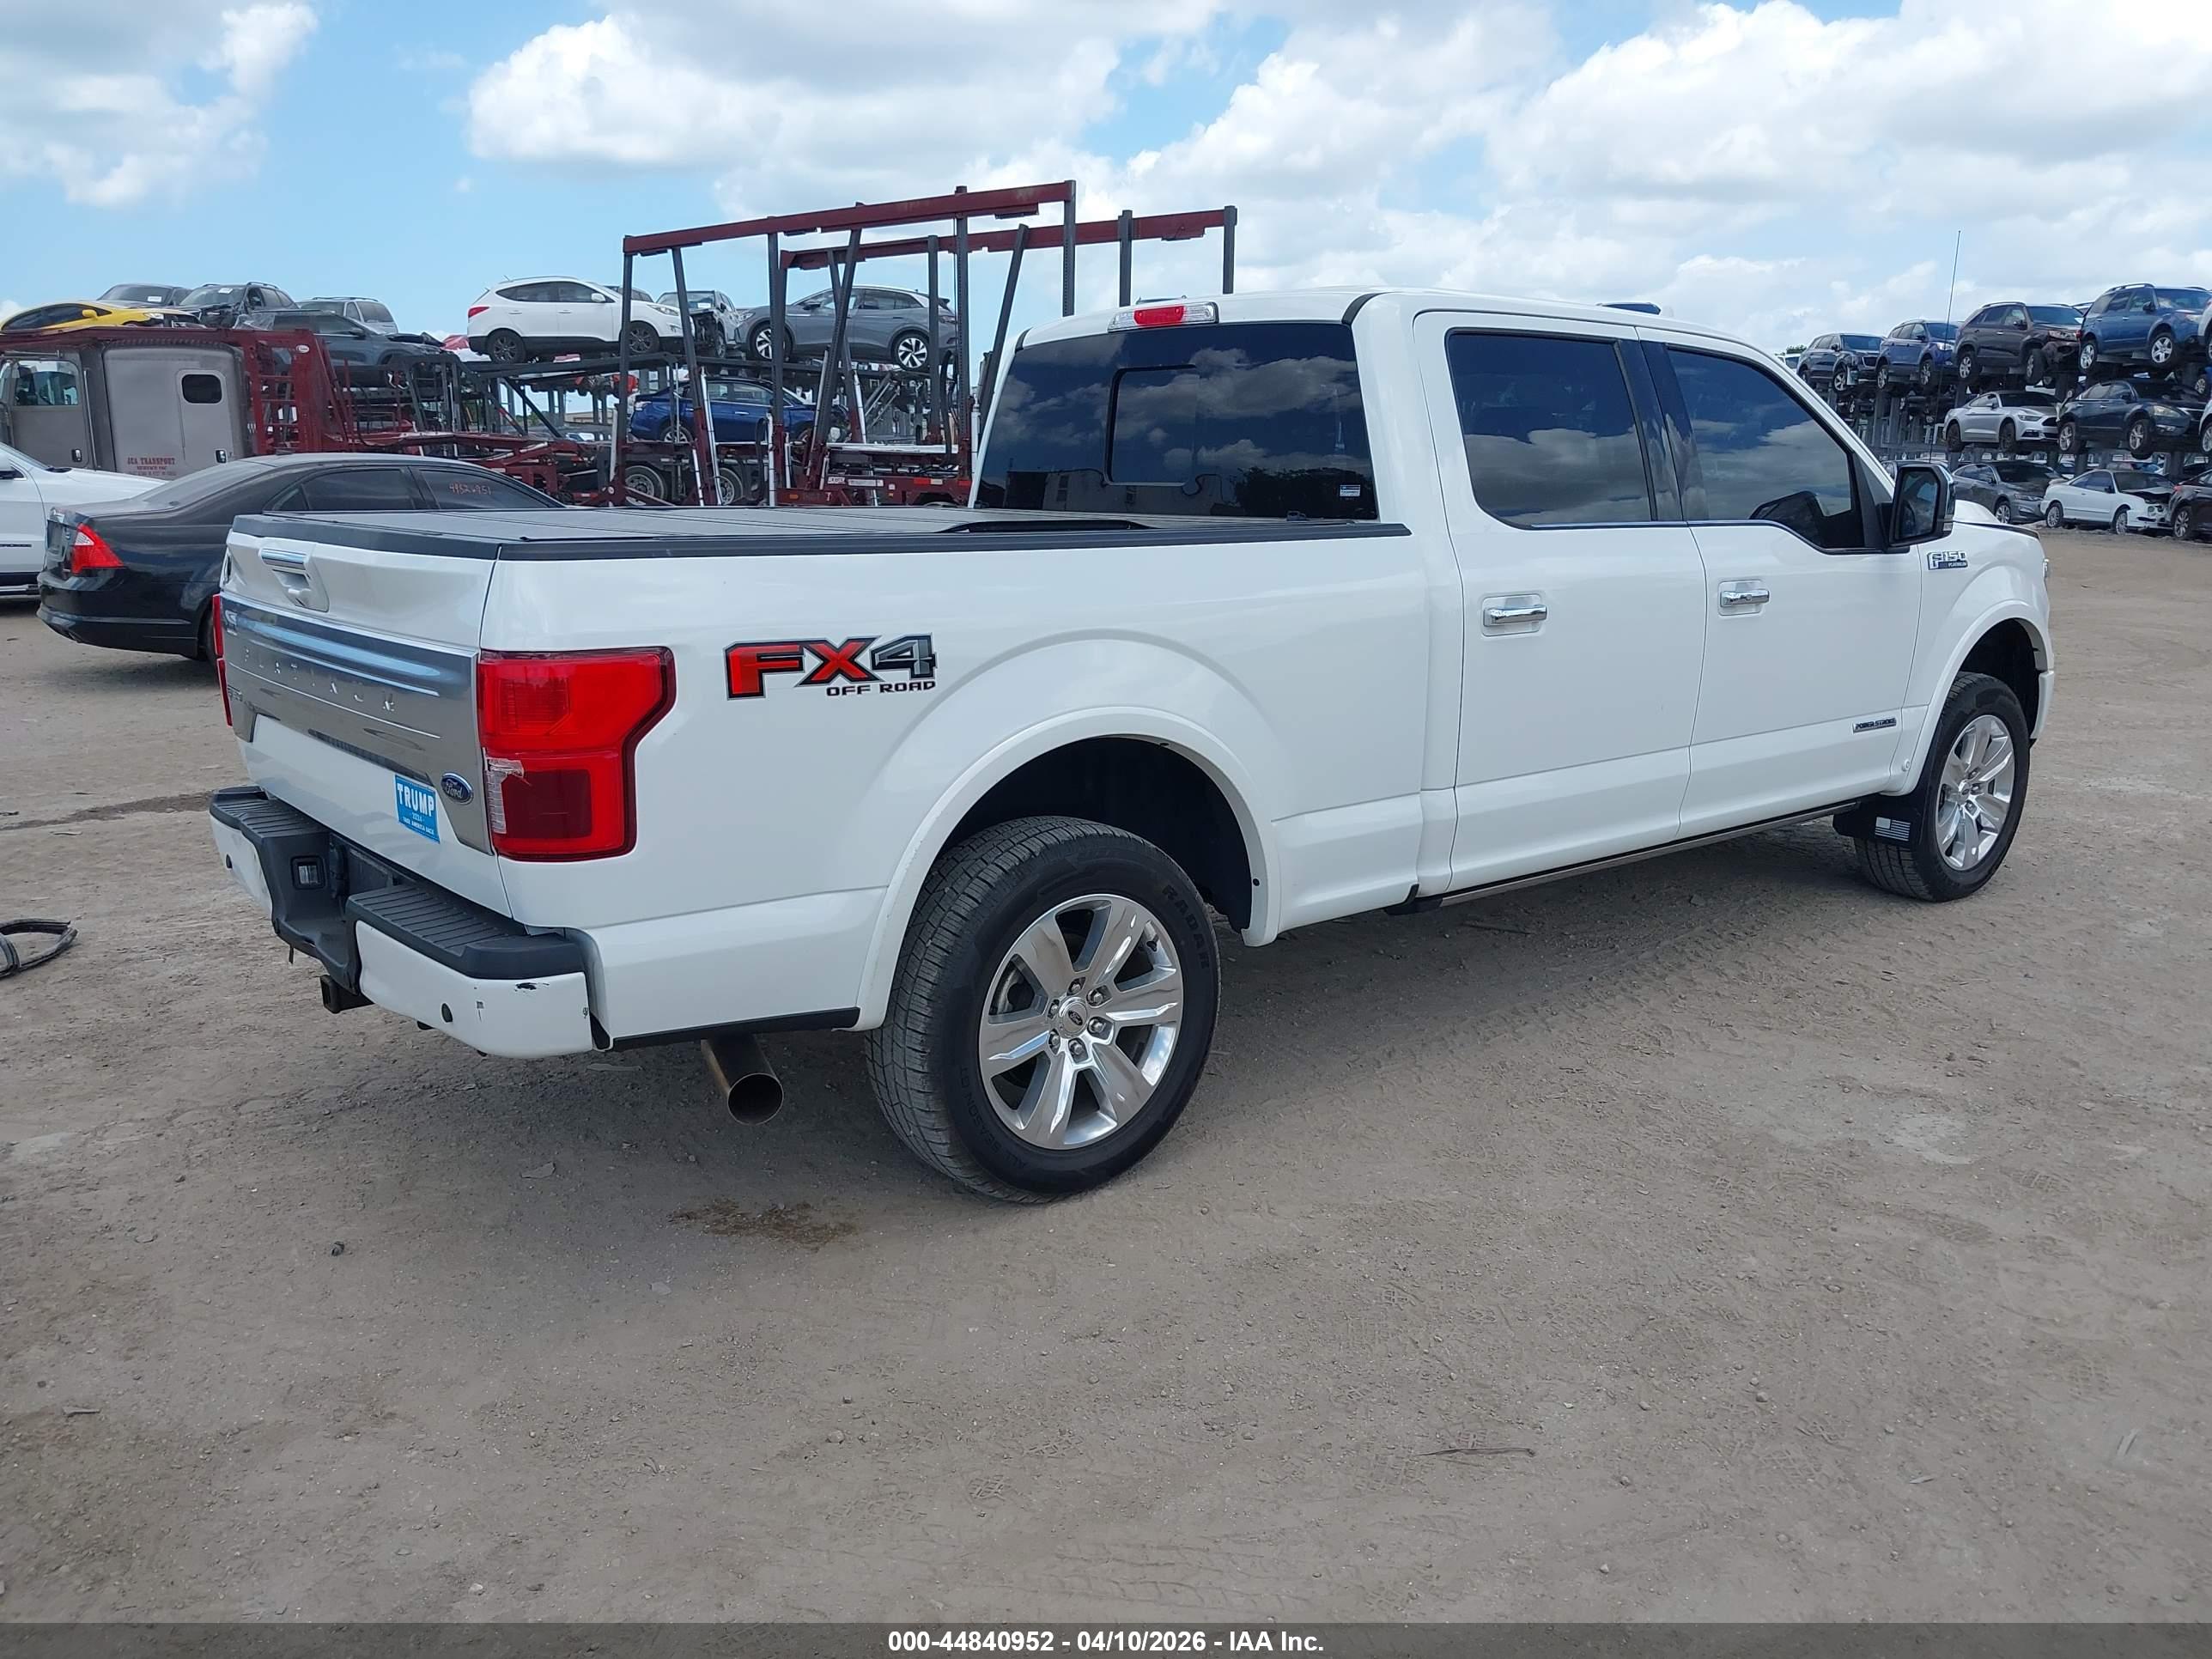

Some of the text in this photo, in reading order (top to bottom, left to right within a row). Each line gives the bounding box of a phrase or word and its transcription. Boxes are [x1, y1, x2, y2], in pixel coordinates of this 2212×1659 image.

[722, 632, 938, 701] FX4
[826, 680, 936, 696] OFF ROAD
[397, 782, 434, 817] TRUMP
[445, 778, 463, 799] Ford
[1162, 884, 1210, 969] RADAR
